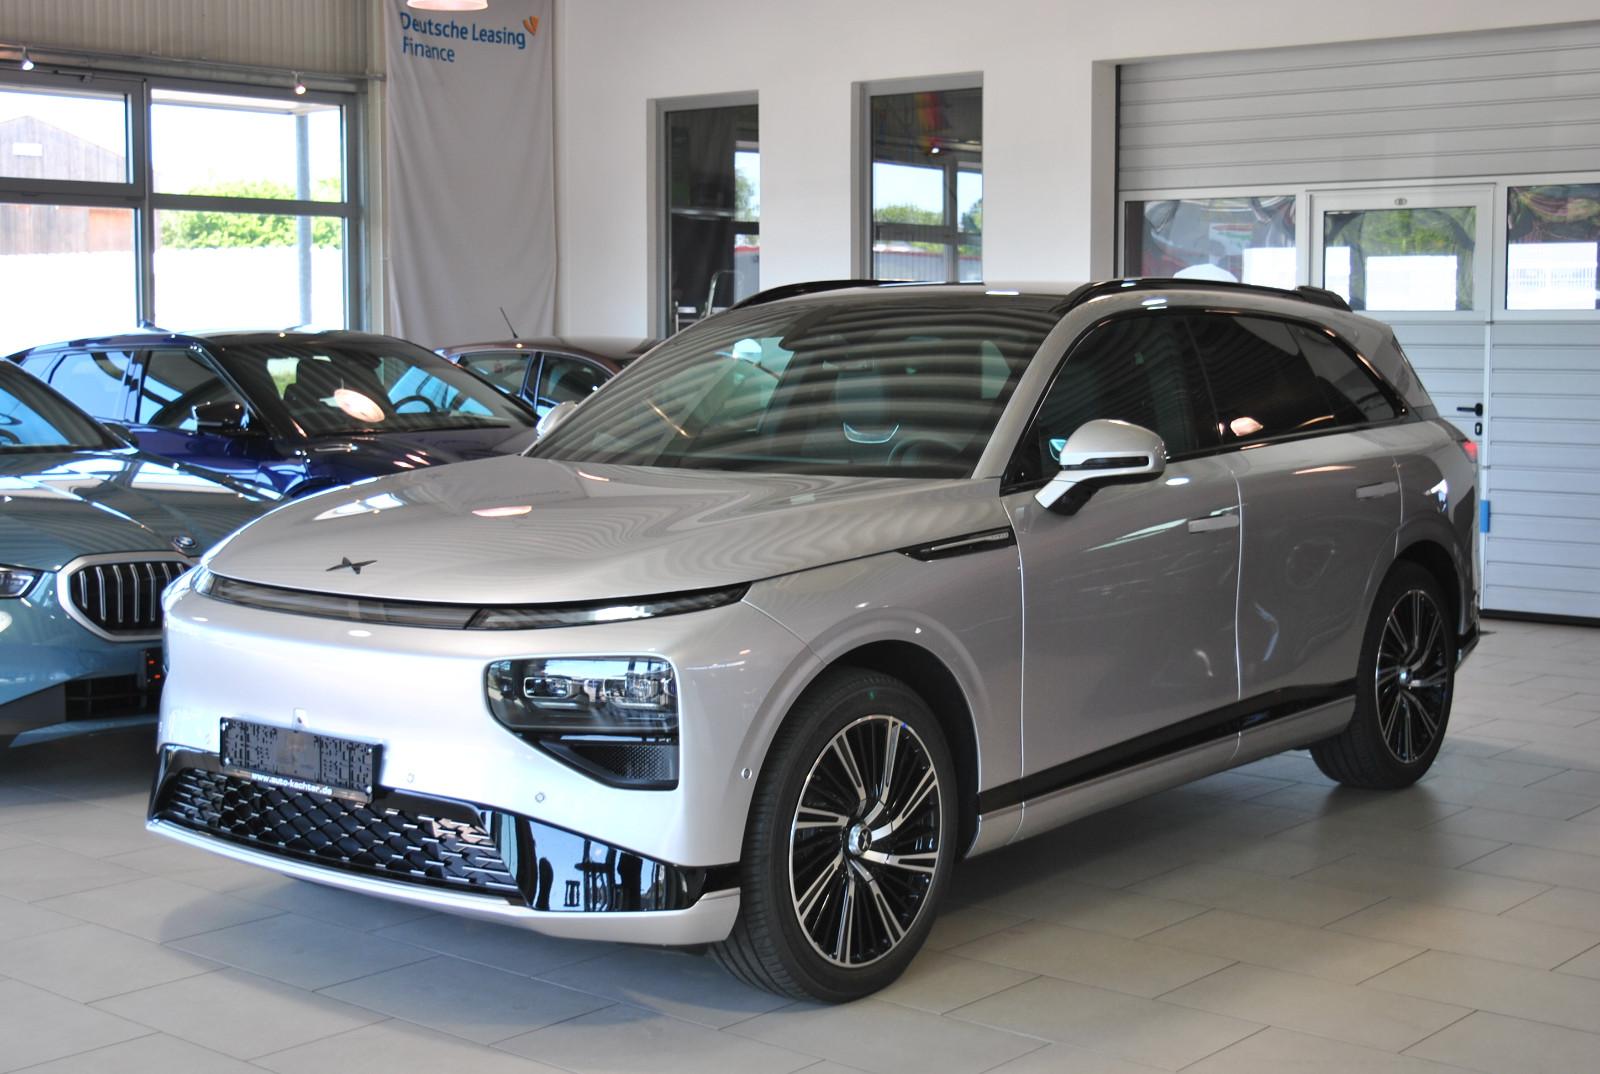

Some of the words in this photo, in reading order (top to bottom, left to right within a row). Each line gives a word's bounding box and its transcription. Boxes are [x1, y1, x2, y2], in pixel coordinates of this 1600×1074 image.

[400, 12, 468, 40] Deutsche
[472, 24, 526, 50] Leasing
[403, 36, 455, 62] Finance
